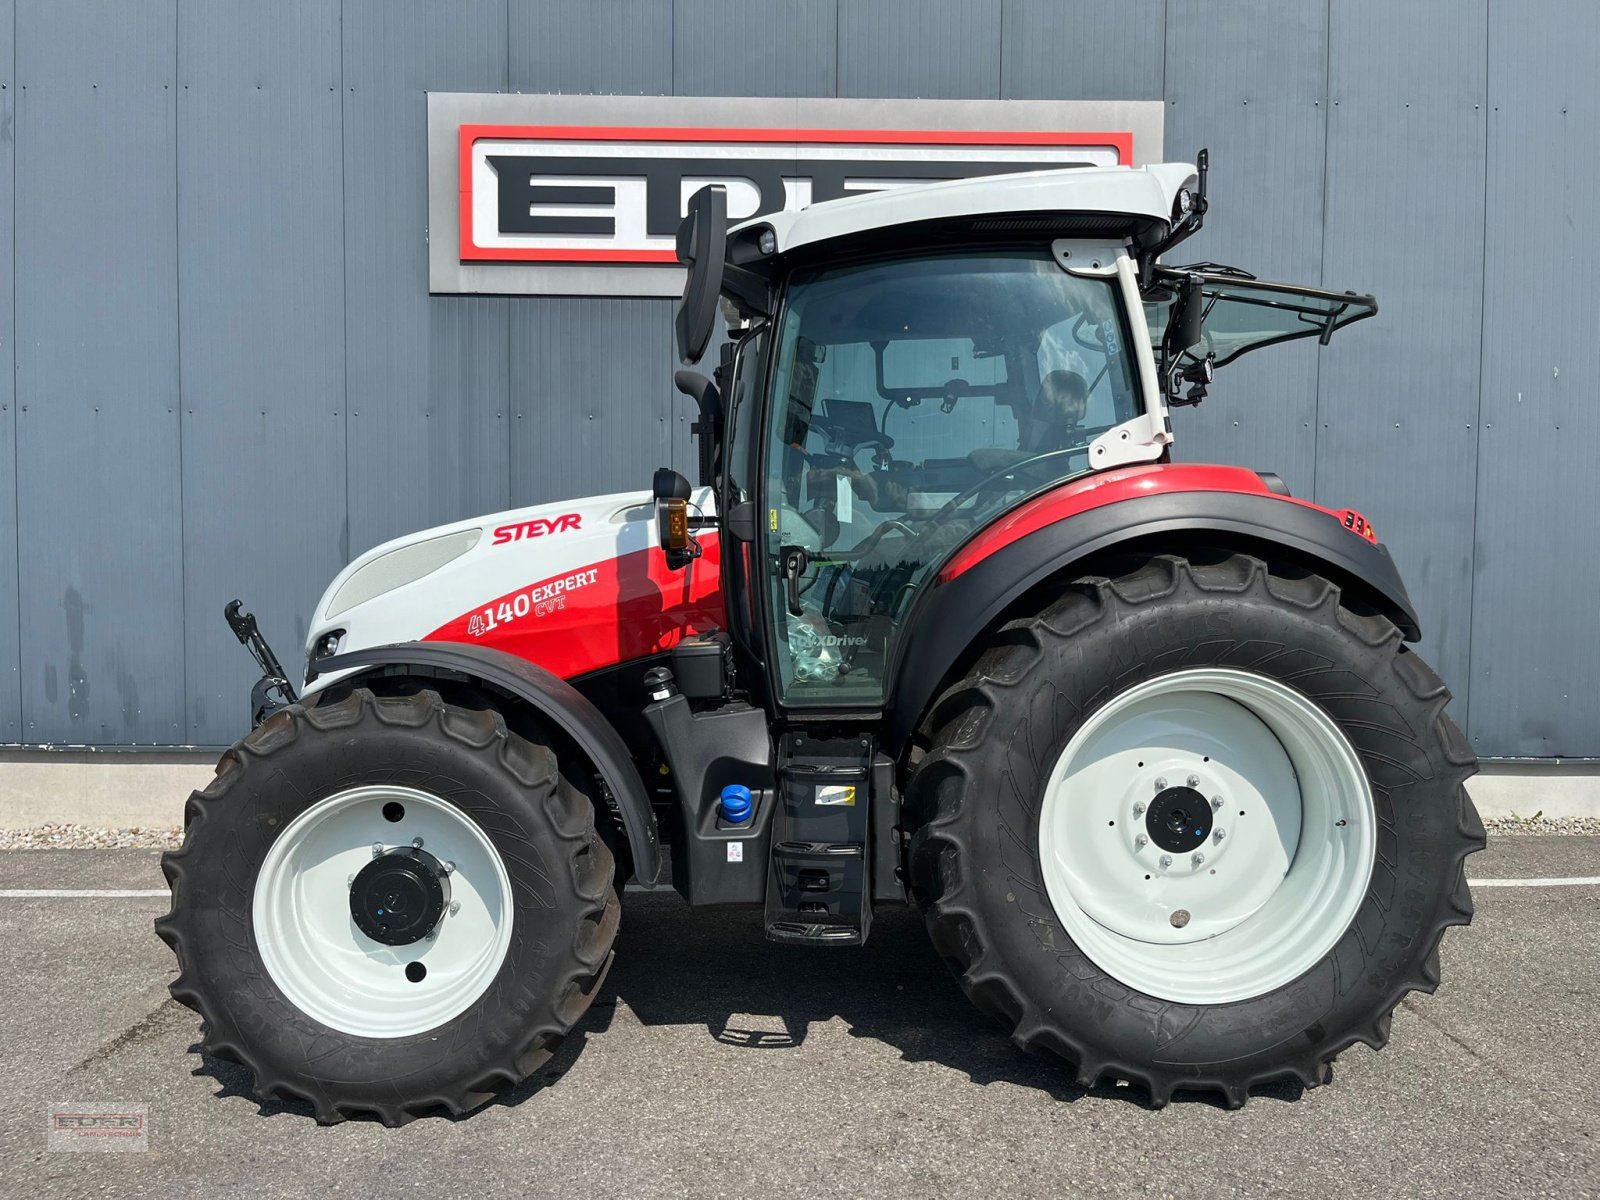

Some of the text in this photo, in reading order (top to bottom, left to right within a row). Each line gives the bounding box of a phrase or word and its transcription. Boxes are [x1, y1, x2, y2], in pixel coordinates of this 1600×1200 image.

[485, 155, 1098, 235] ED
[491, 513, 582, 546] STEYR
[467, 568, 598, 637] 4140 EXPERT
[535, 594, 566, 617] CVT
